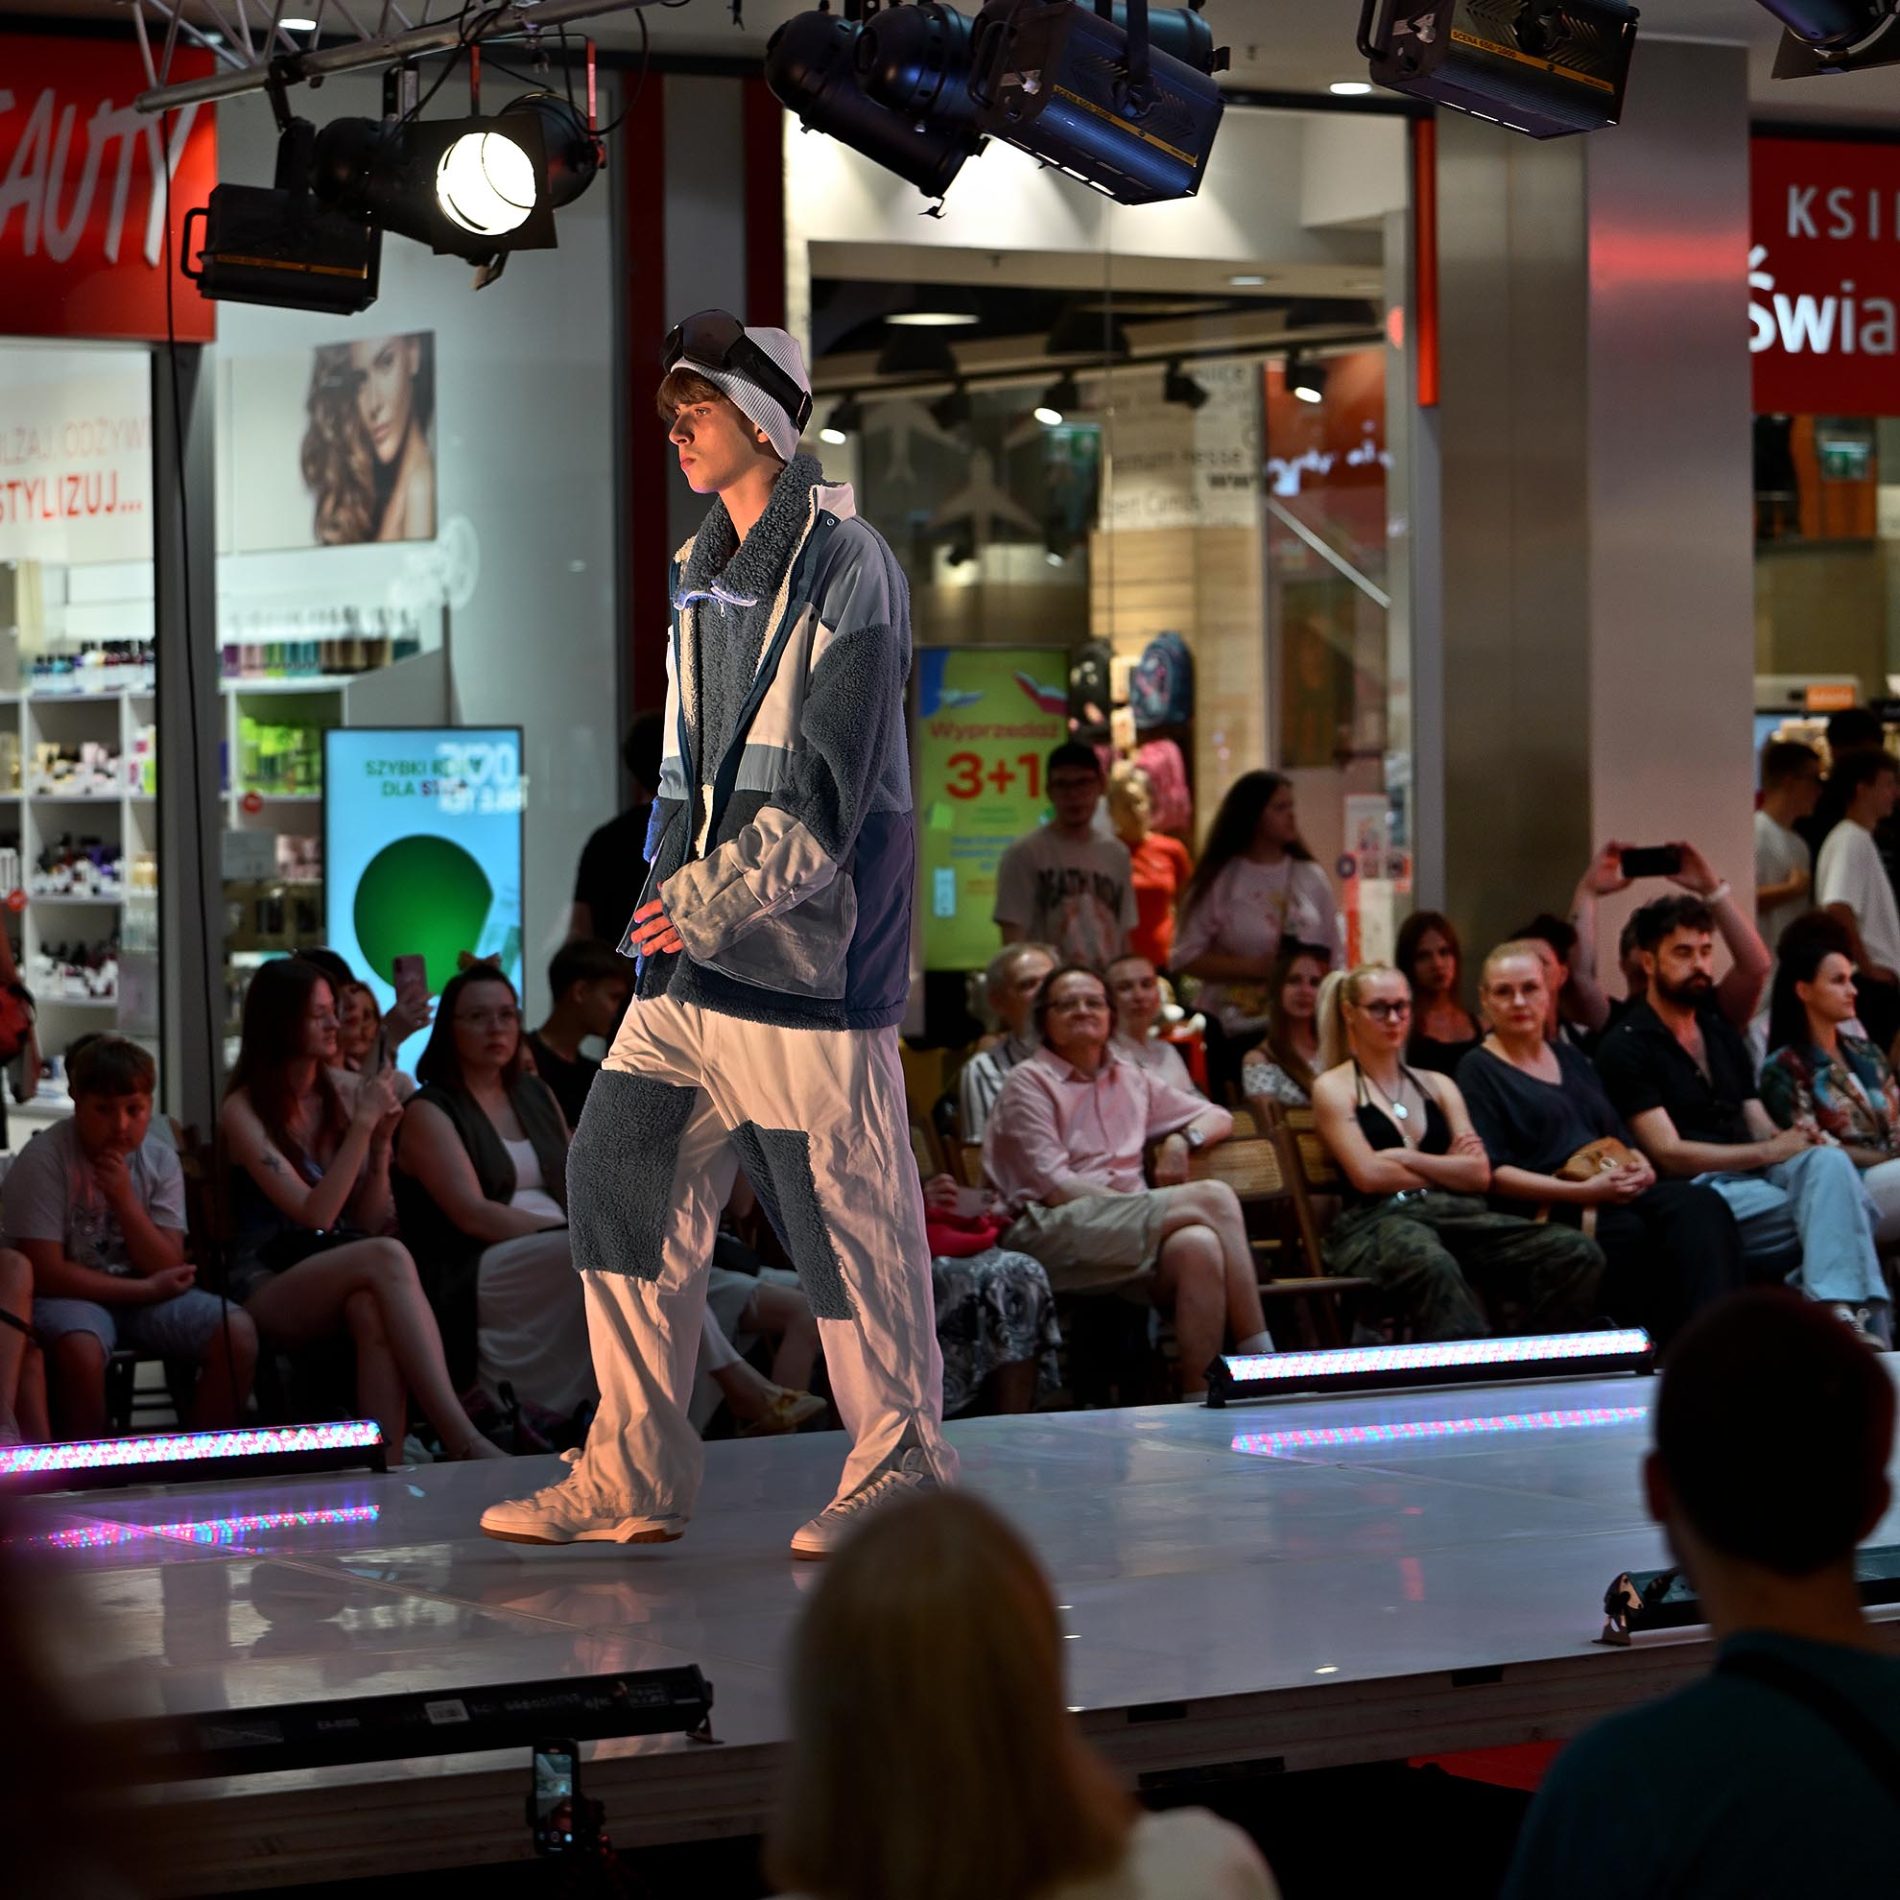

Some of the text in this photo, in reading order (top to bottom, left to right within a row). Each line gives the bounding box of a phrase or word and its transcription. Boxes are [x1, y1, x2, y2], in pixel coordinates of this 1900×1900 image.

[1787, 184, 1900, 242] KSI
[365, 759, 427, 776] SZYBKI
[945, 752, 1041, 799] 3+1
[381, 780, 416, 797] DLA
